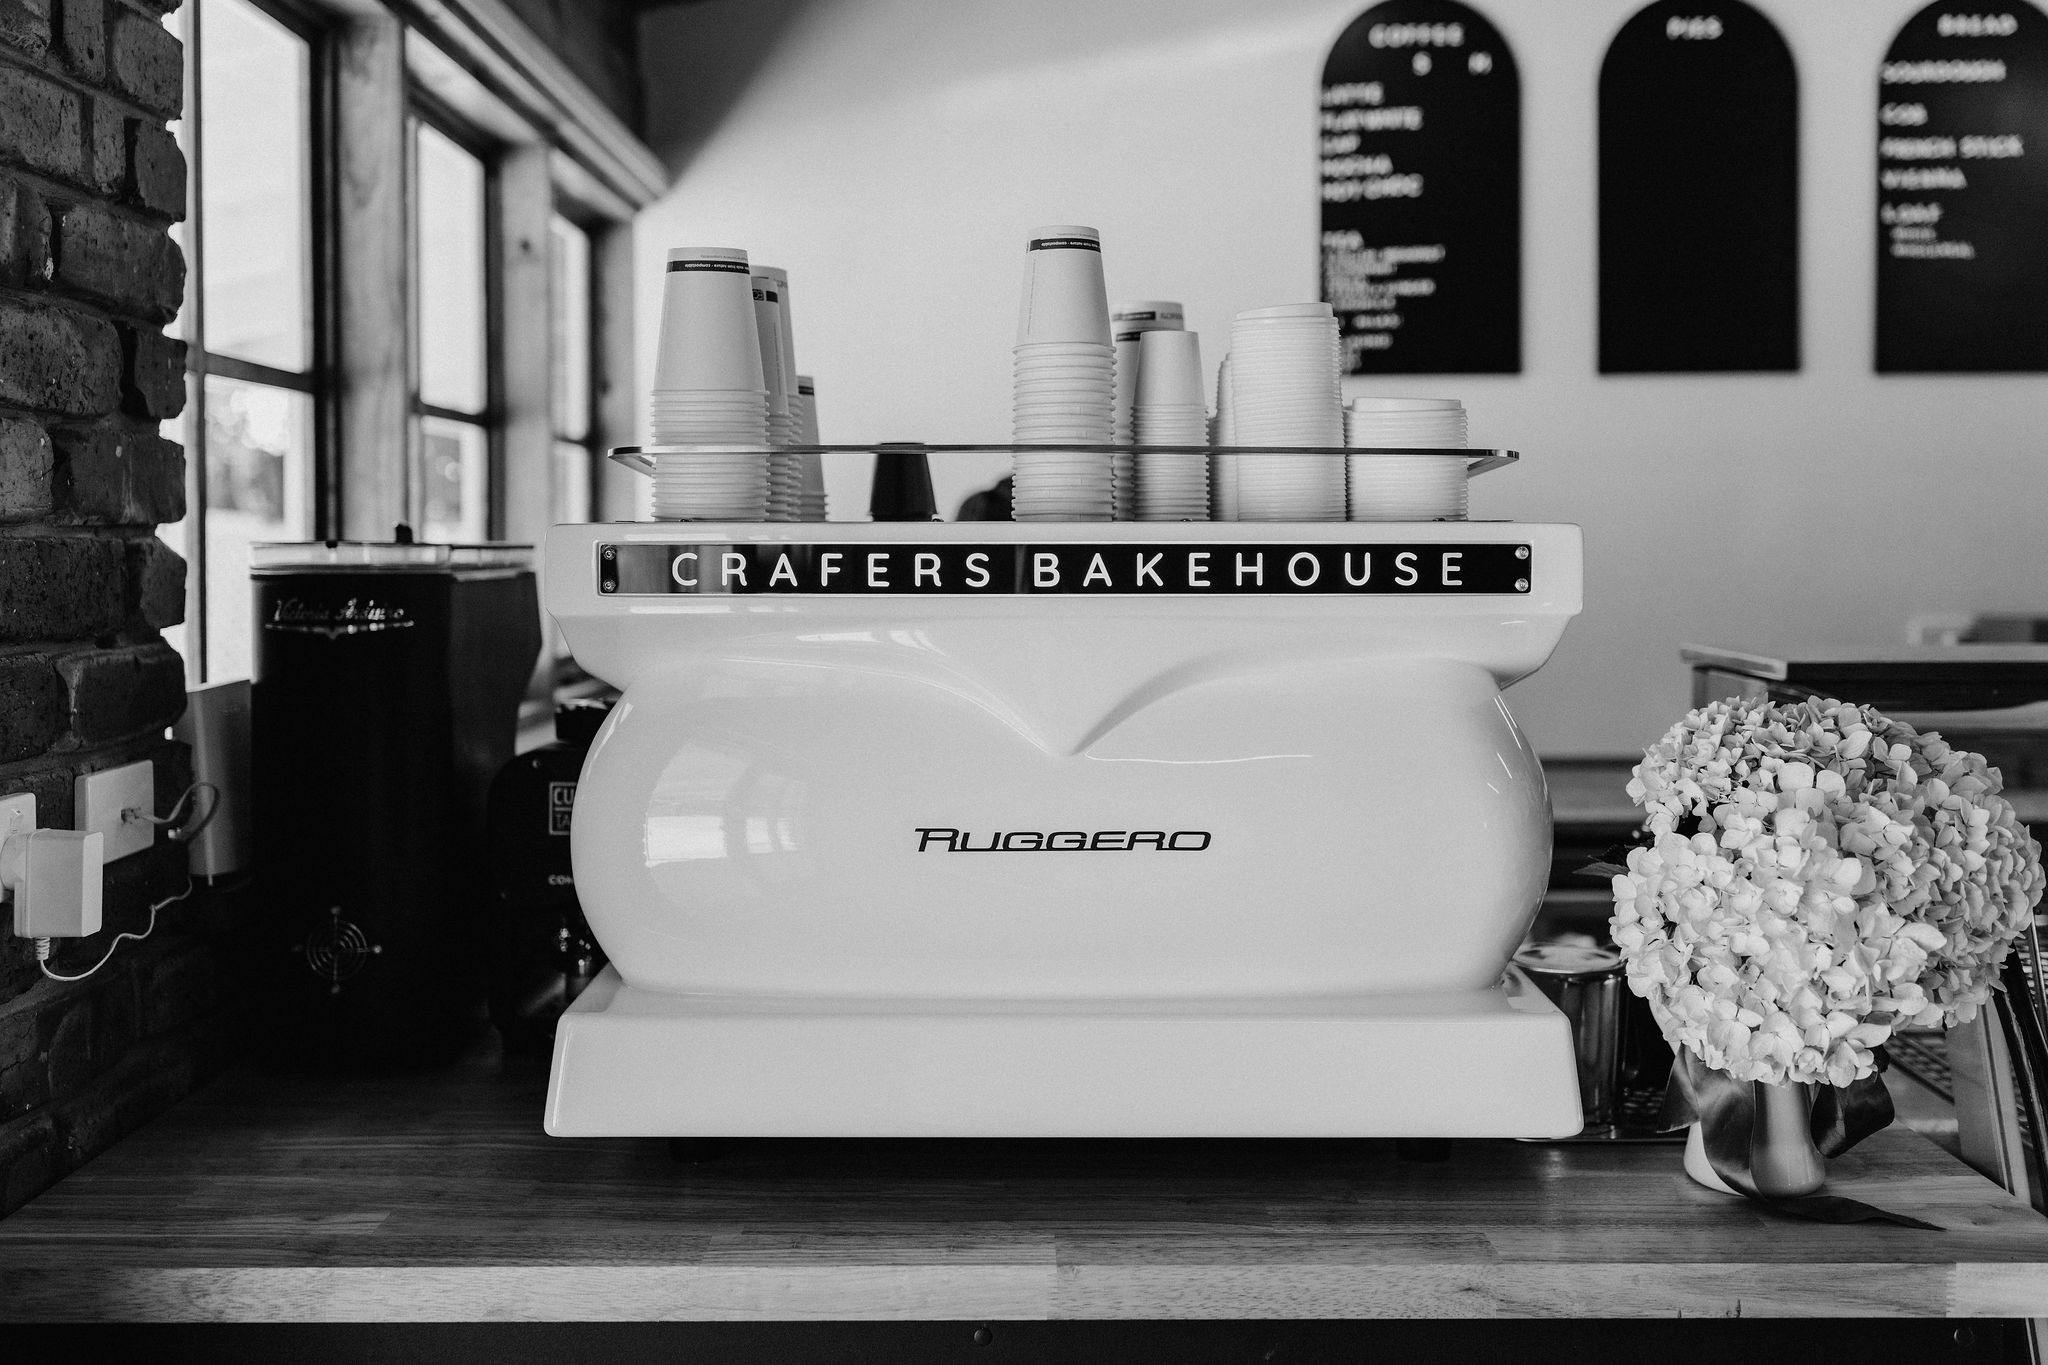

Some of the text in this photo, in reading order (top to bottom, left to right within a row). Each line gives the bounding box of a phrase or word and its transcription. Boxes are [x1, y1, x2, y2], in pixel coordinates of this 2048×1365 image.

[1368, 22, 1464, 48] COFFEE
[1937, 13, 2018, 37] BREAD
[671, 552, 1463, 588] CRAFERS BAKEHOUSE
[914, 827, 1212, 852] RUGGERO
